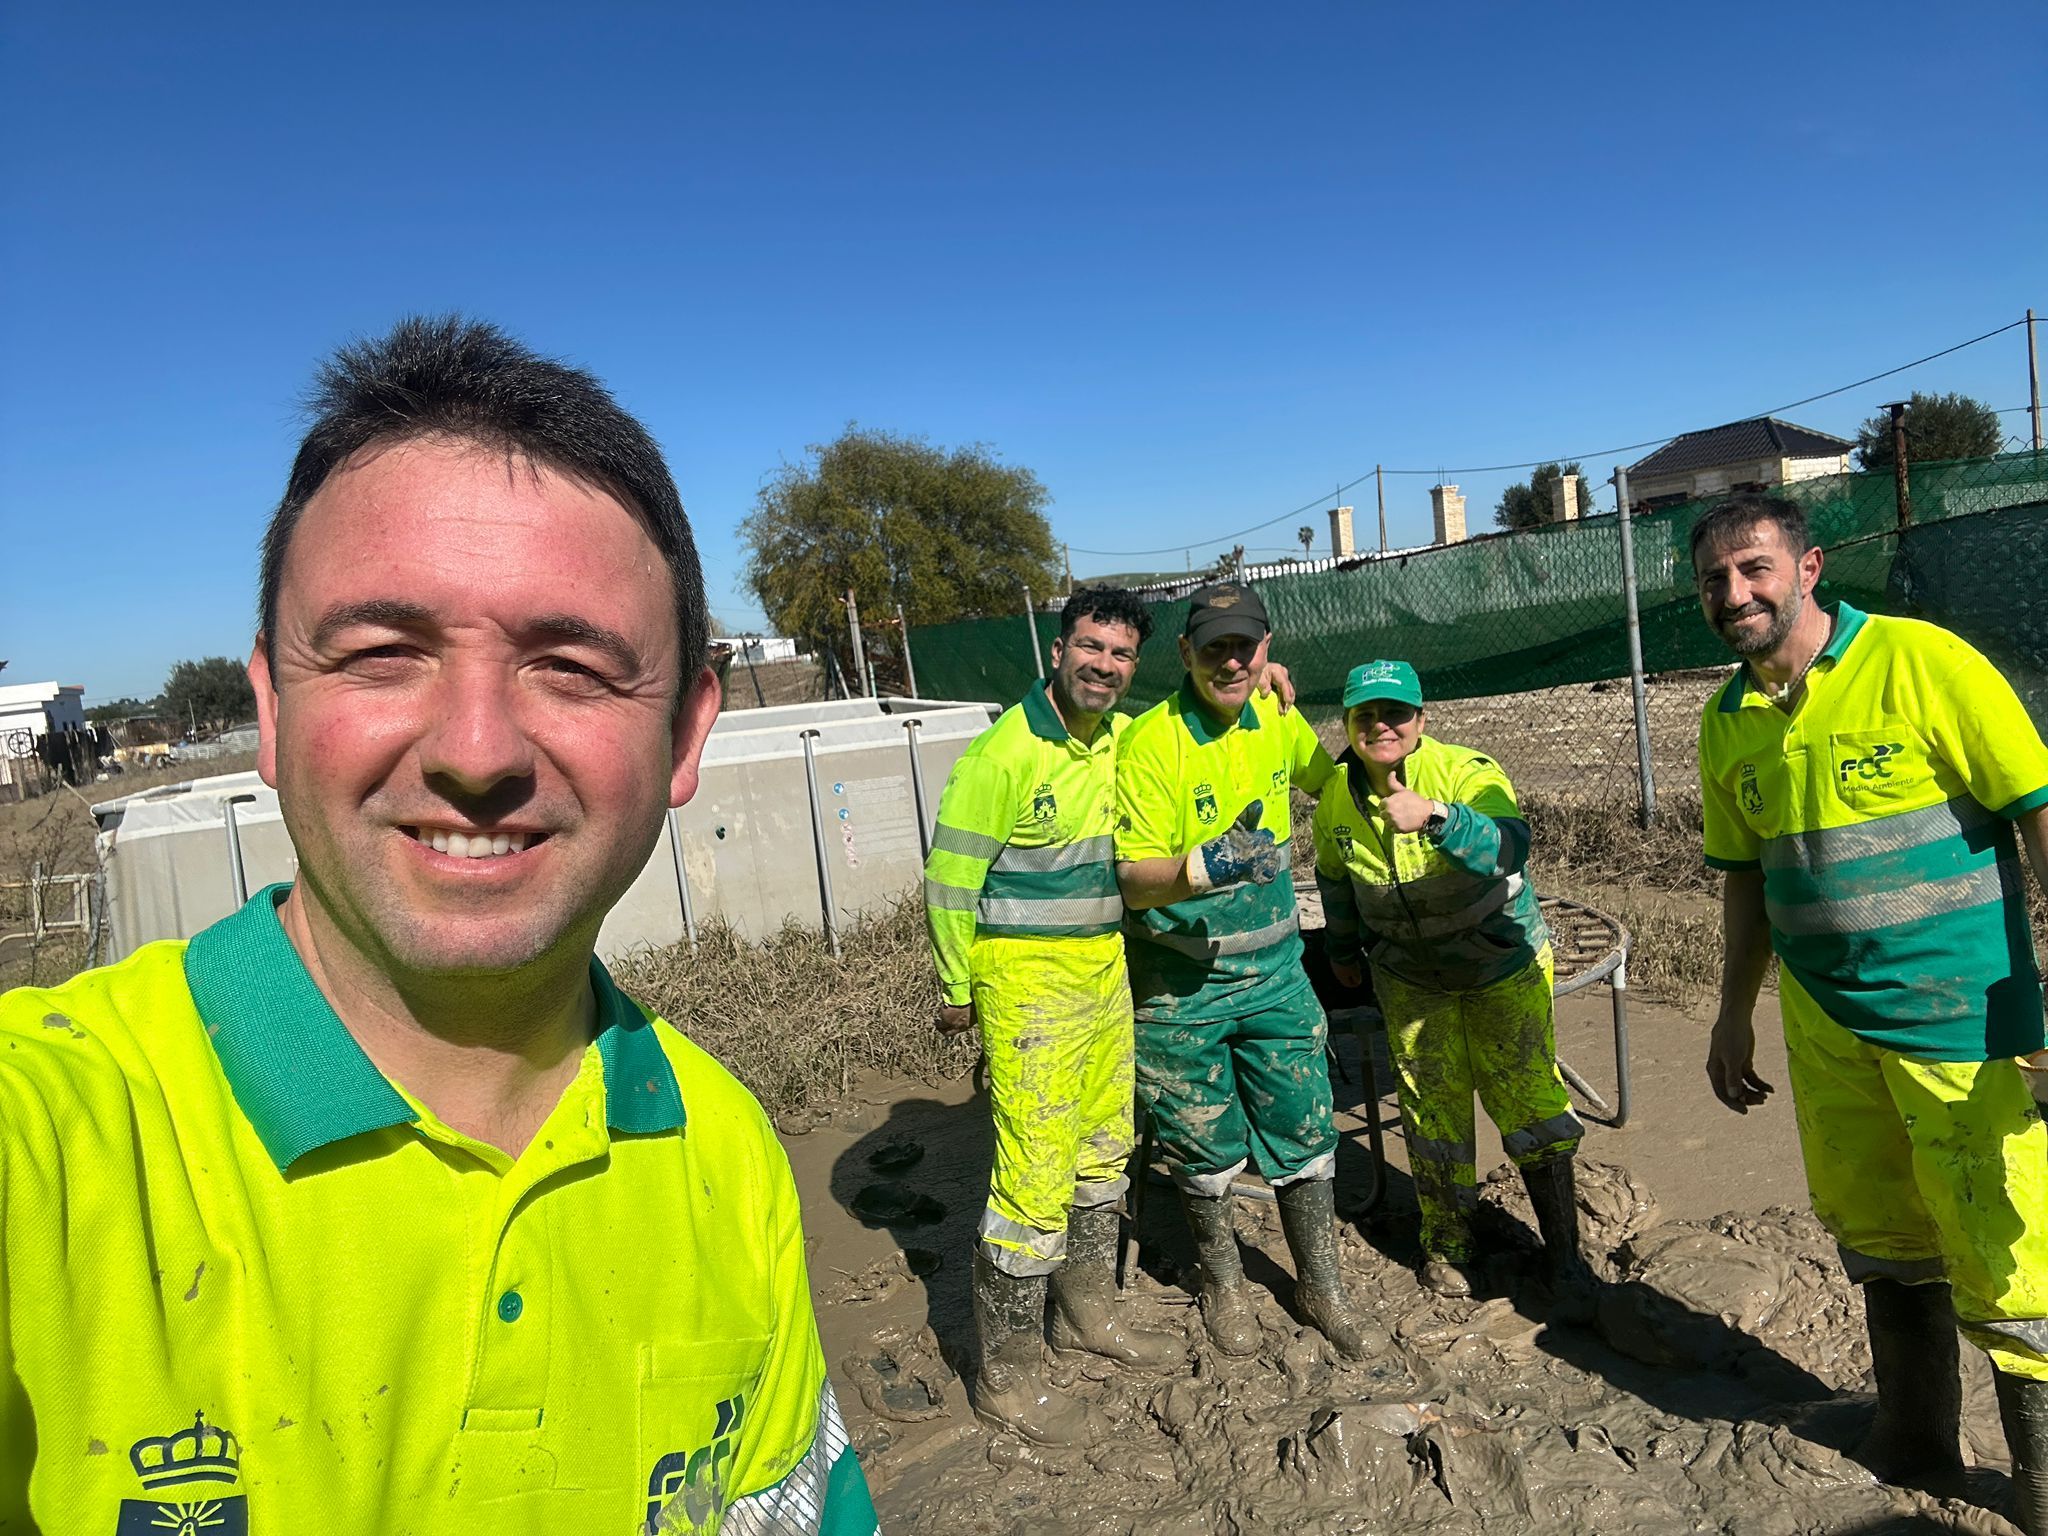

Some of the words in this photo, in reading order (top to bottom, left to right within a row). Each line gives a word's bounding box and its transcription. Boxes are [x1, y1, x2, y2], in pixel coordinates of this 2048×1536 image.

[1840, 756, 1894, 782] FCC
[1843, 784, 1870, 793] Medio
[1872, 777, 1914, 791] Ambiente
